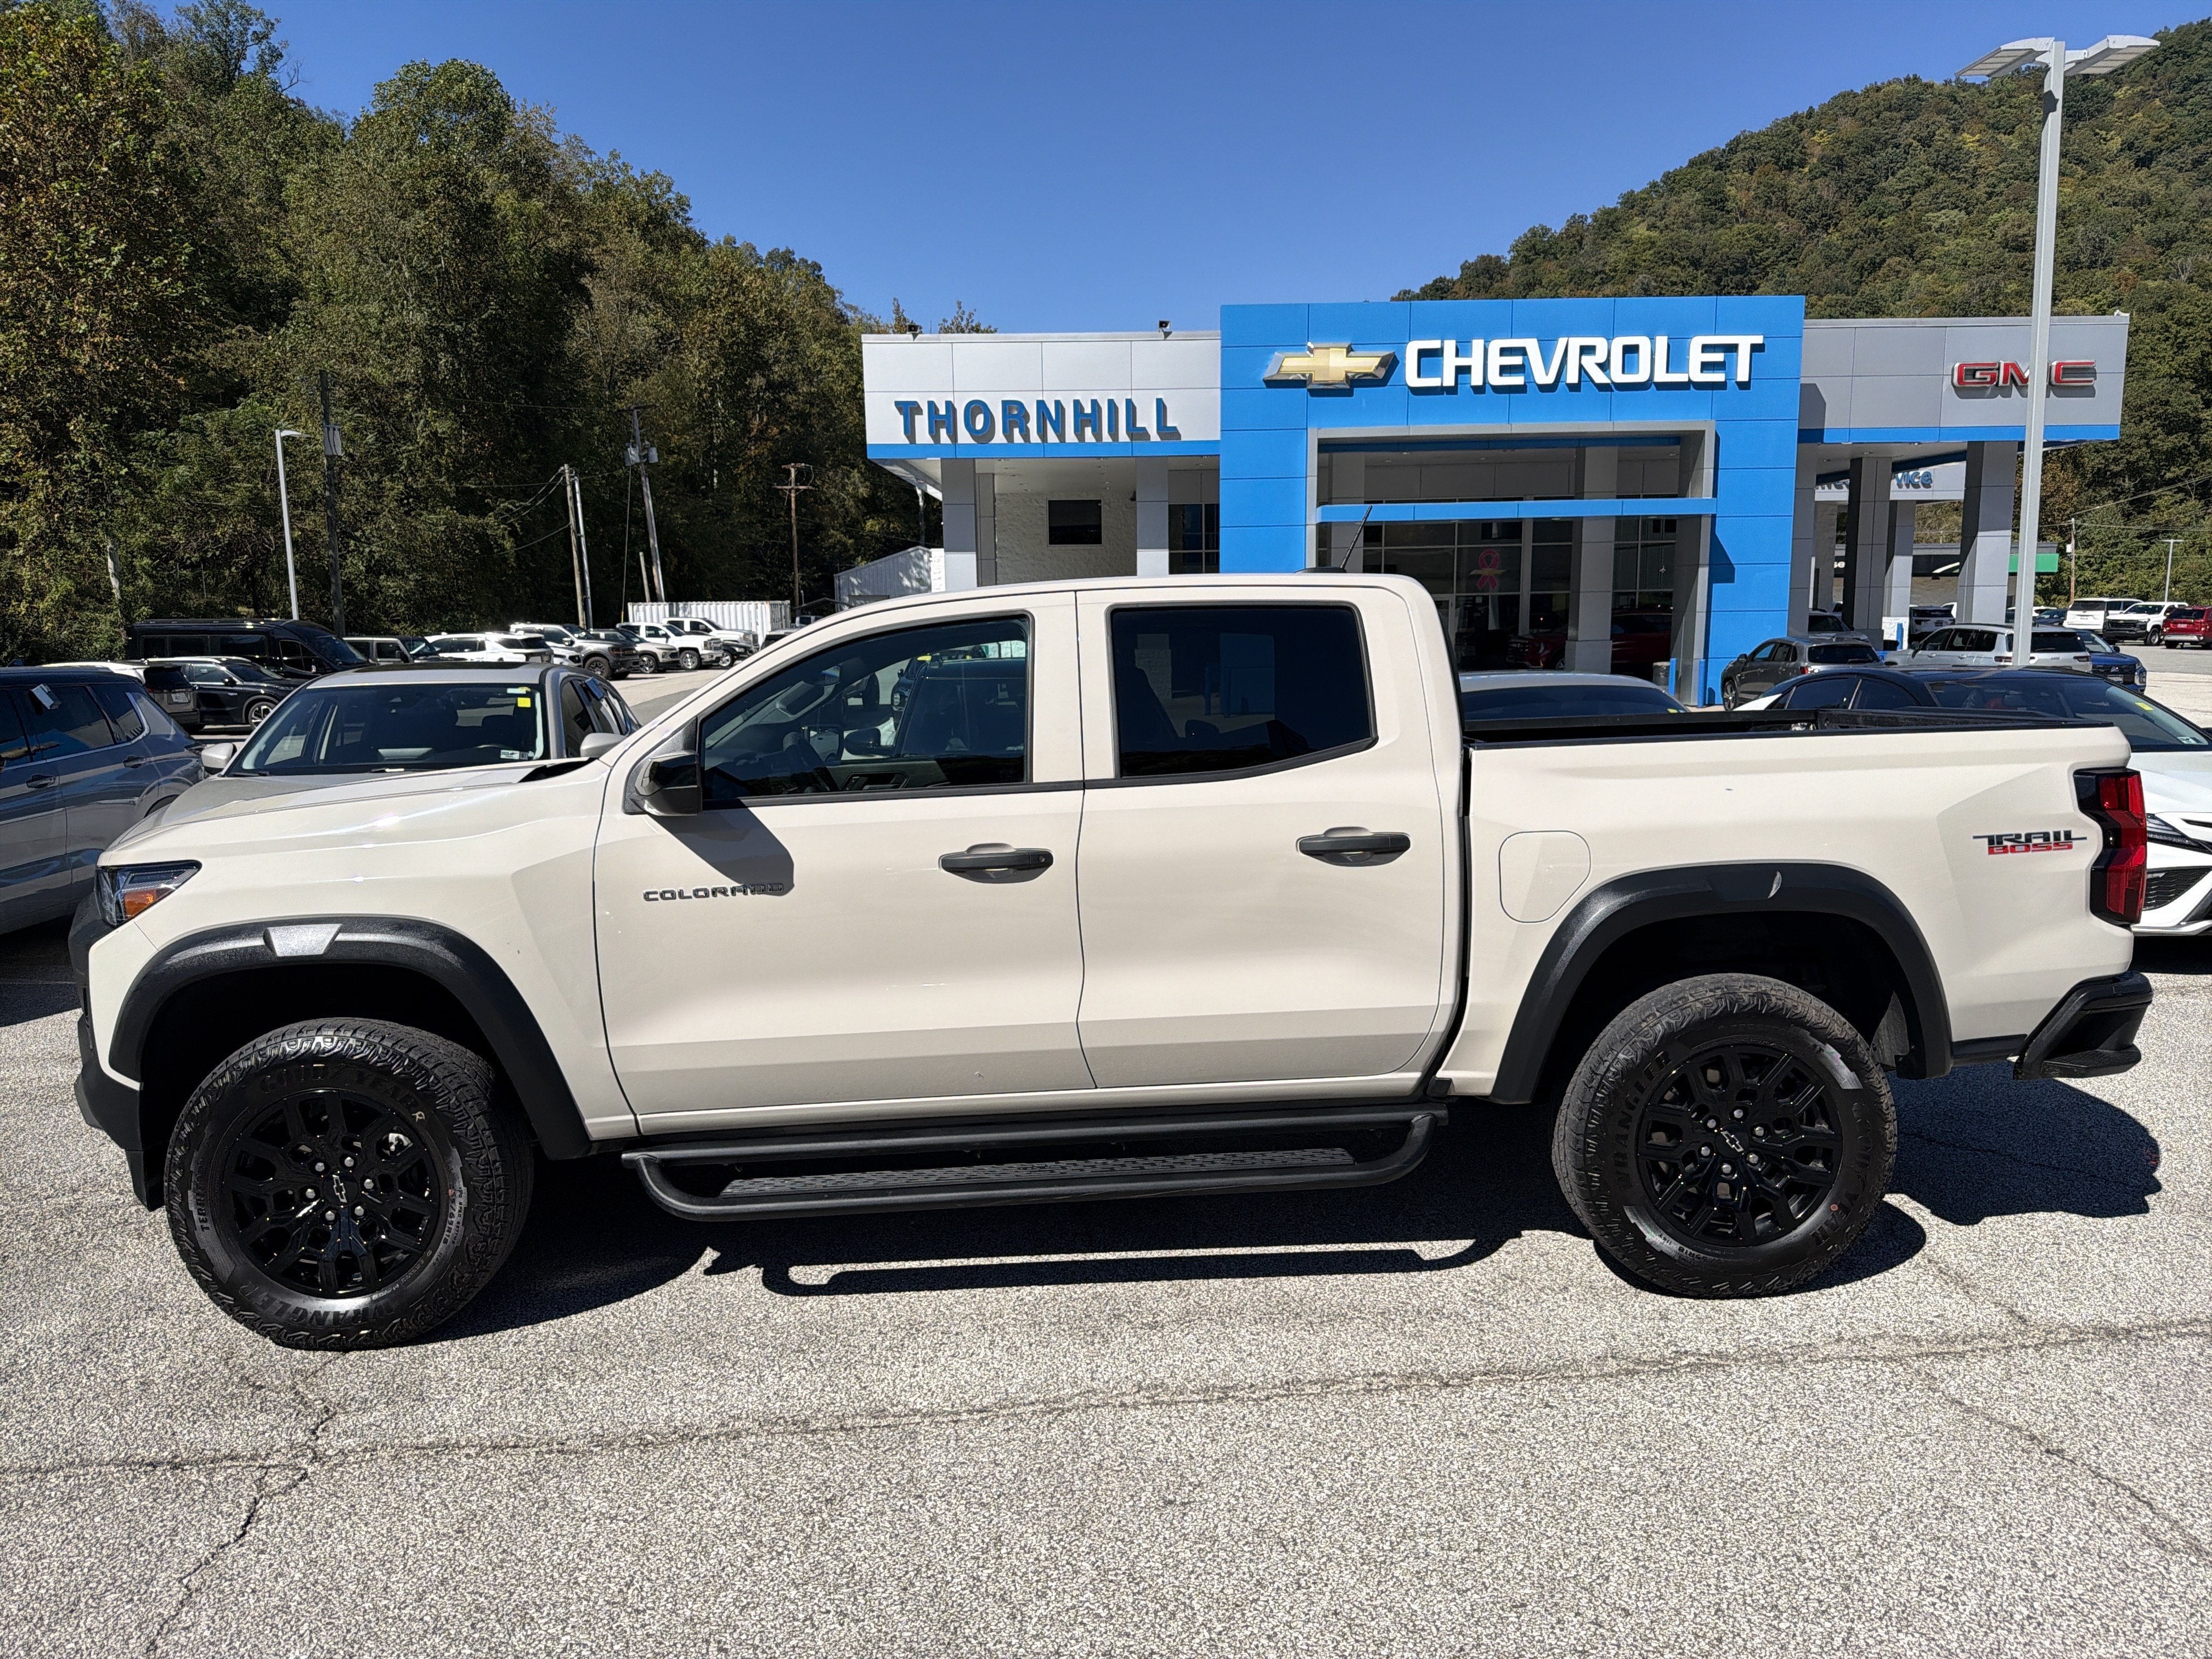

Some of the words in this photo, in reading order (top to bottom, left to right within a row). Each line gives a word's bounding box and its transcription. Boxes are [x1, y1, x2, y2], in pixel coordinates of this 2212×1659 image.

[1405, 335, 1764, 387] CHEVROLET
[1952, 359, 2096, 387] GMC
[894, 398, 1178, 436] THORNHILL
[1894, 470, 1933, 484] vice
[1972, 830, 2087, 846] TRAIL
[1988, 841, 2073, 855] BOSS
[643, 883, 783, 901] COLORADO
